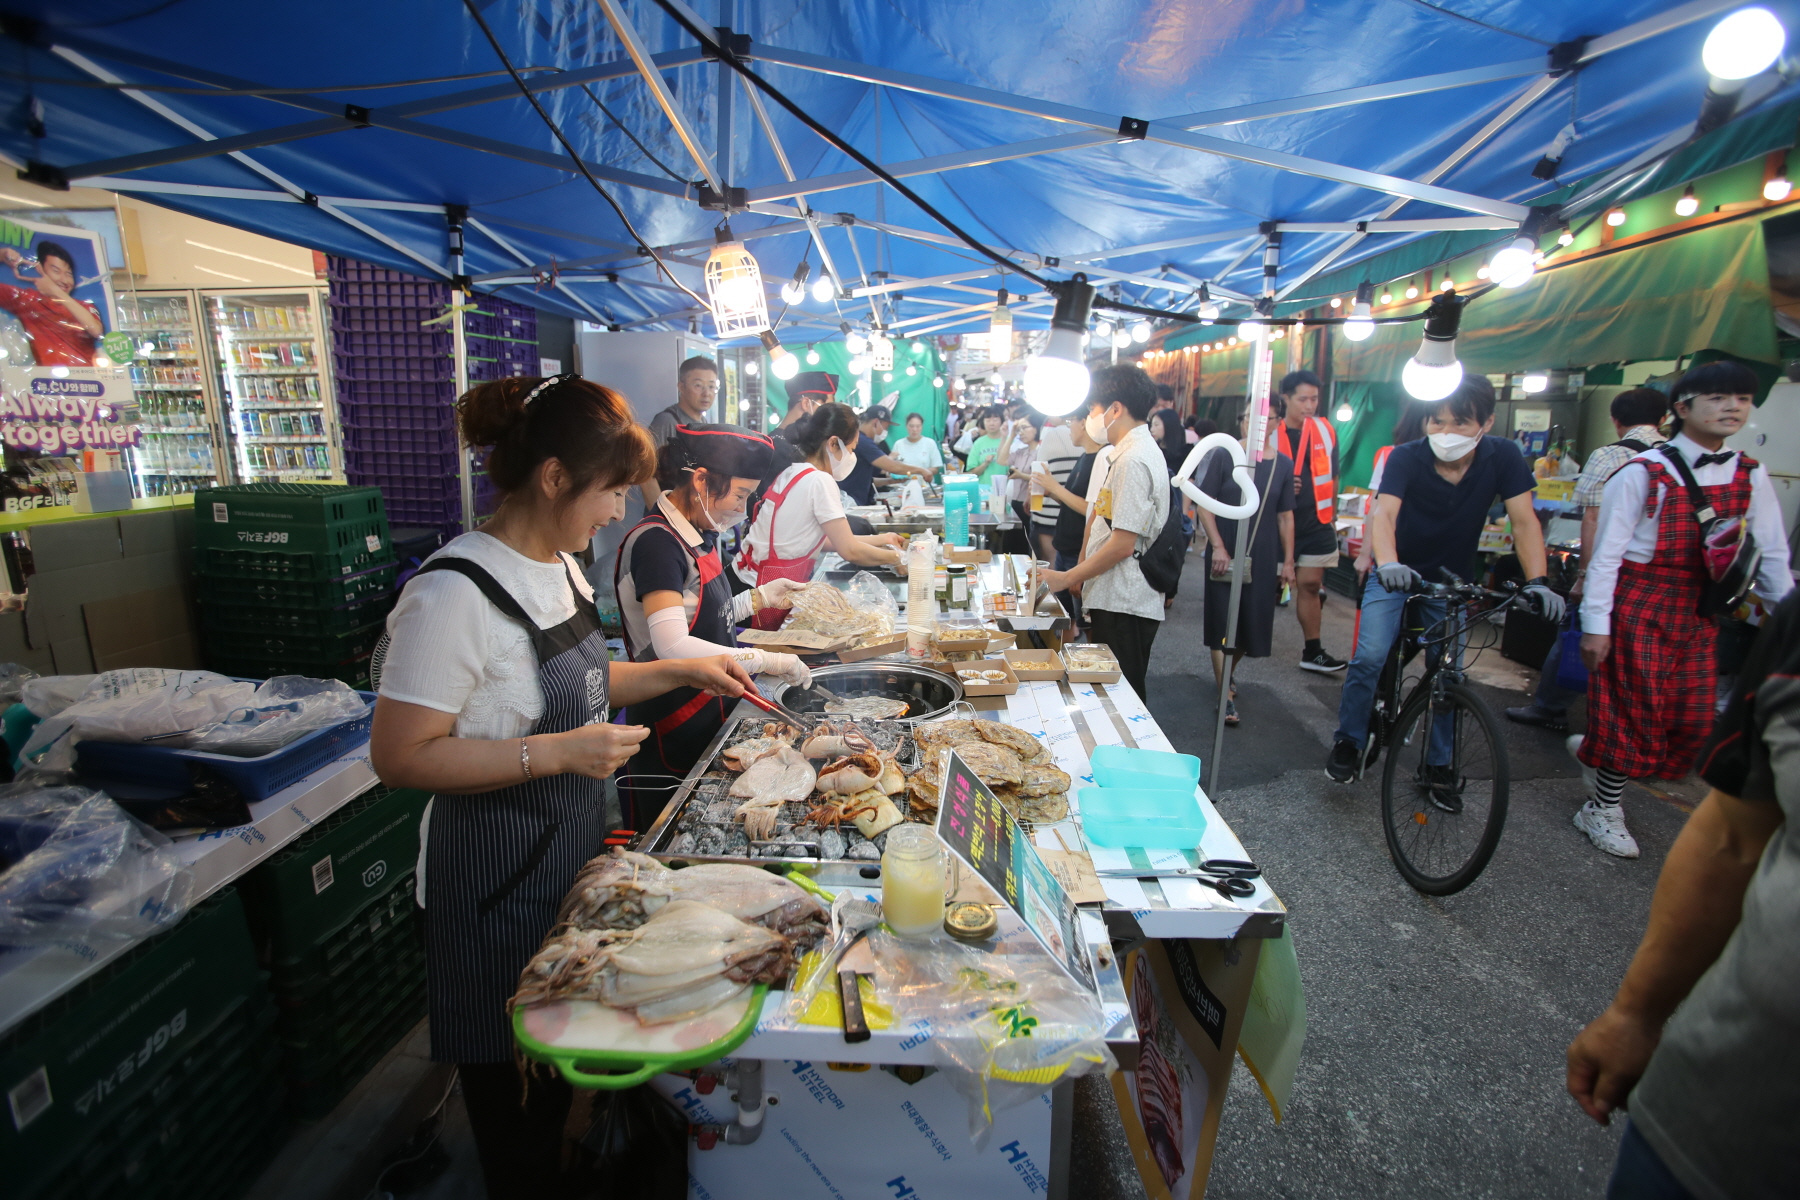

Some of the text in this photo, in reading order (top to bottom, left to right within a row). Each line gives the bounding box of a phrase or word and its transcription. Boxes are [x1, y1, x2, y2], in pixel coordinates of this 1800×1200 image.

[107, 341, 129, 354] 24/7
[0, 393, 113, 423] Always
[2, 420, 138, 451] together
[237, 531, 289, 543] BGF로지스
[950, 772, 970, 838] 진성식품
[970, 789, 987, 862] 맥반석 오징어
[1005, 867, 1017, 898] 쥐포
[74, 1008, 187, 1116] BGF로지스
[798, 1073, 828, 1104] STEEL
[808, 1069, 845, 1110] HYUNDAI
[901, 1100, 953, 1162] 현대제철주식회사
[780, 1127, 802, 1153] Leading
[801, 1151, 813, 1164] the
[810, 1163, 823, 1177] new
[820, 1176, 831, 1187] era
[829, 1186, 839, 1195] of
[1014, 1163, 1039, 1194] STEEL
